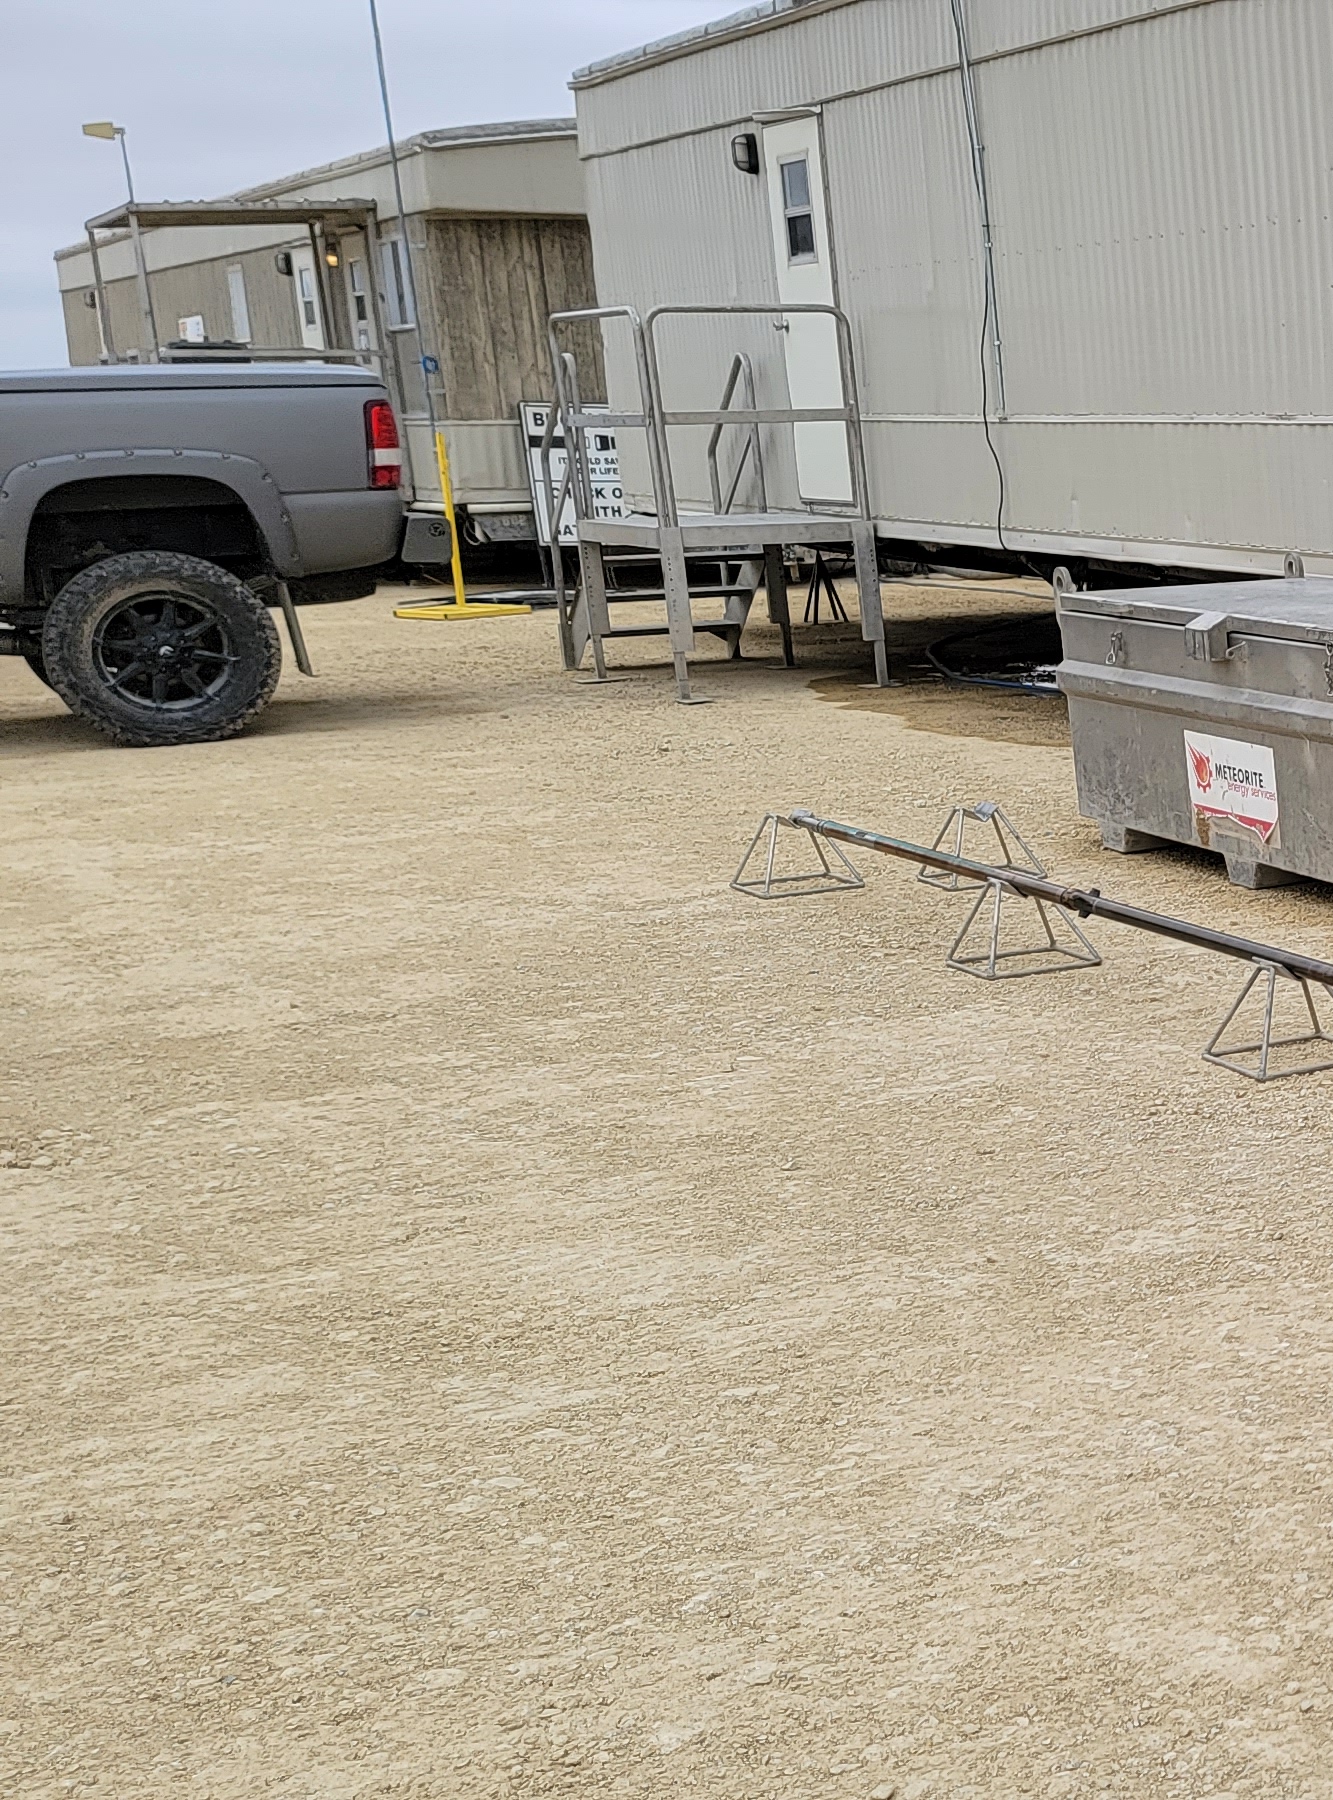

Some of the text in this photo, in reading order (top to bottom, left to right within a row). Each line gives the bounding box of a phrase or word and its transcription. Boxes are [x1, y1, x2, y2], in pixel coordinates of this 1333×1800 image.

[595, 506, 622, 517] ITH
[1215, 763, 1264, 788] METEORITE
[1228, 782, 1276, 801] energy services
